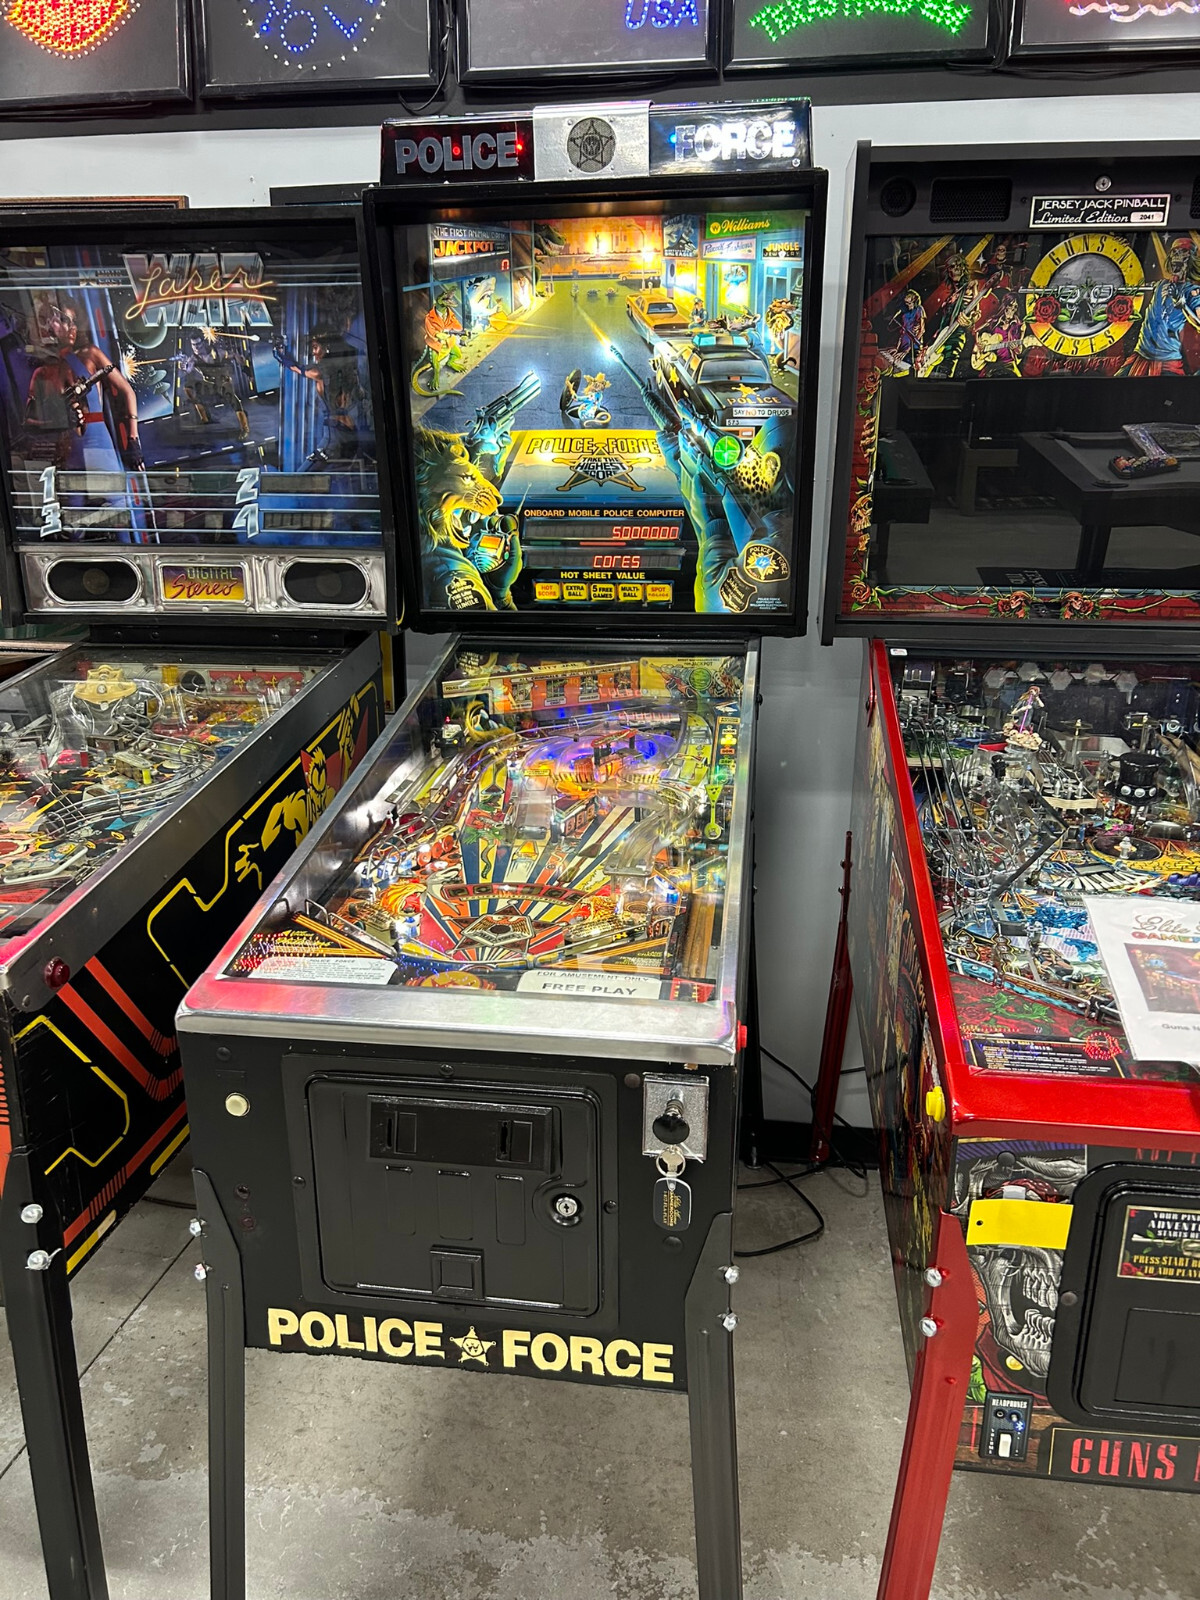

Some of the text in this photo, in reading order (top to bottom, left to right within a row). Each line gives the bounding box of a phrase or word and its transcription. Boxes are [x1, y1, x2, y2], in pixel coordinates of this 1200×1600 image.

[674, 121, 796, 162] FORCE
[394, 131, 519, 175] POLICE
[1038, 198, 1165, 211] JERSEY JACK PINBALL
[1034, 211, 1085, 223] Limited
[1085, 210, 1128, 223] Edition
[436, 226, 449, 237] THE
[449, 227, 467, 237] FIRST
[721, 218, 771, 233] Williams
[434, 240, 495, 257] JACKPOT
[766, 242, 800, 252] JUNGLE
[1049, 235, 1107, 266] GUNS
[126, 265, 278, 320] Laser
[1040, 328, 1115, 355] ROSES
[727, 394, 781, 405] POLICE
[745, 409, 757, 417] NO
[526, 437, 662, 454] POLICE FORCE
[575, 462, 627, 471] HIGHEST
[39, 465, 261, 504] 1 2
[524, 509, 566, 517] ONBOARD
[568, 509, 601, 517] MOBILE
[40, 502, 260, 539] 3 4
[749, 546, 772, 554] POLICE
[776, 556, 788, 575] FORCE
[187, 567, 238, 580] DIGITAL
[171, 574, 238, 599] Stereo
[558, 972, 619, 980] AMUSEMENT
[542, 982, 637, 996] FREE PLAY
[1162, 1023, 1190, 1031] Guns
[1153, 1212, 1179, 1220] YOUR
[1147, 1220, 1200, 1231] ADVENT
[1157, 1230, 1188, 1238] STARTS
[1133, 1255, 1161, 1264] PRESS
[1161, 1256, 1190, 1267] START
[1144, 1266, 1155, 1274] TO
[1158, 1267, 1174, 1276] ADD
[267, 1307, 674, 1383] POLICE FORCE
[991, 1398, 1028, 1409] HEADPHONES
[1070, 1437, 1179, 1481] GUNS
